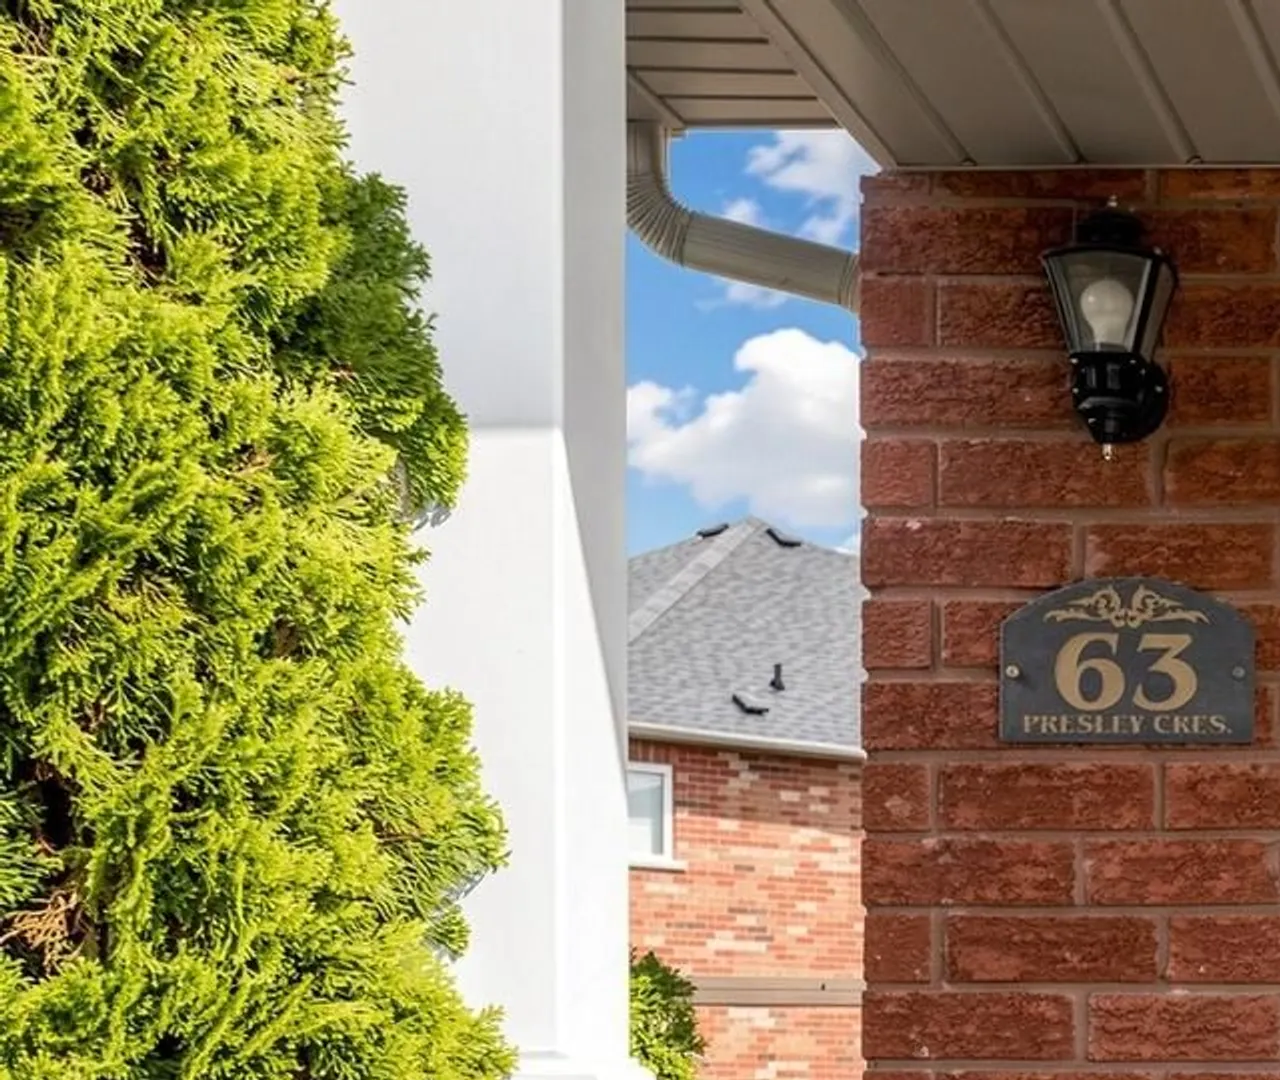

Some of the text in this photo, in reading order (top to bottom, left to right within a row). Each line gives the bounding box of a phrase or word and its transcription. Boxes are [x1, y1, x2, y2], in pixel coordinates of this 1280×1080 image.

[1054, 632, 1197, 711] 63
[1023, 714, 1232, 734] PRESLEY CRES.
